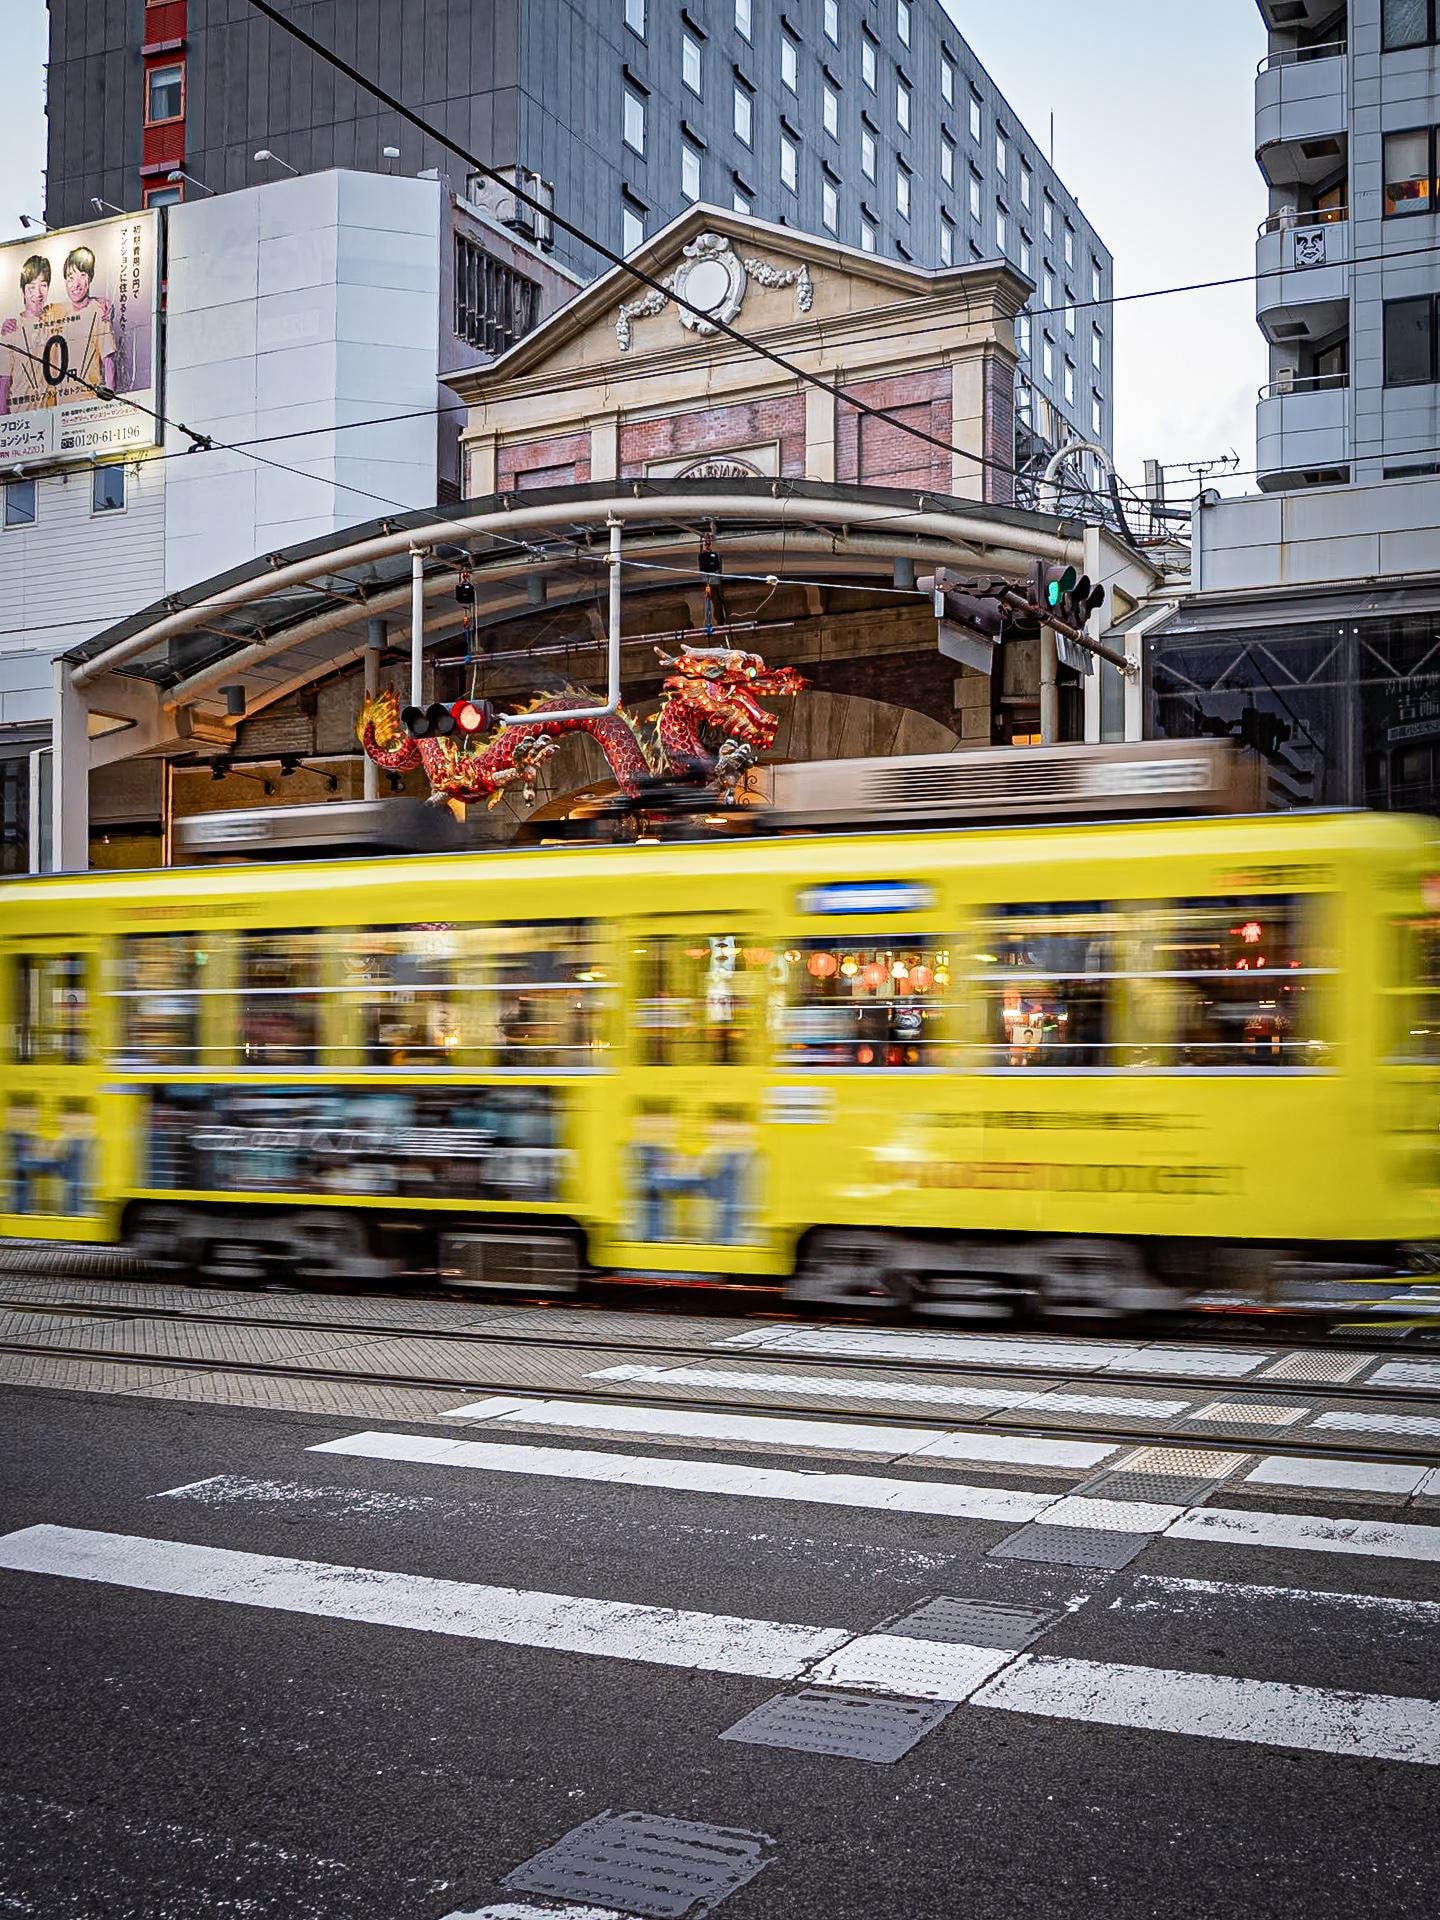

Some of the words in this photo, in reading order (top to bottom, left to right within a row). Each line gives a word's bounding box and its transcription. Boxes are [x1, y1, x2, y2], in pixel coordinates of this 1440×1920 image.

[0, 419, 31, 433] プロジェ
[75, 425, 140, 448] 0120-61-1196
